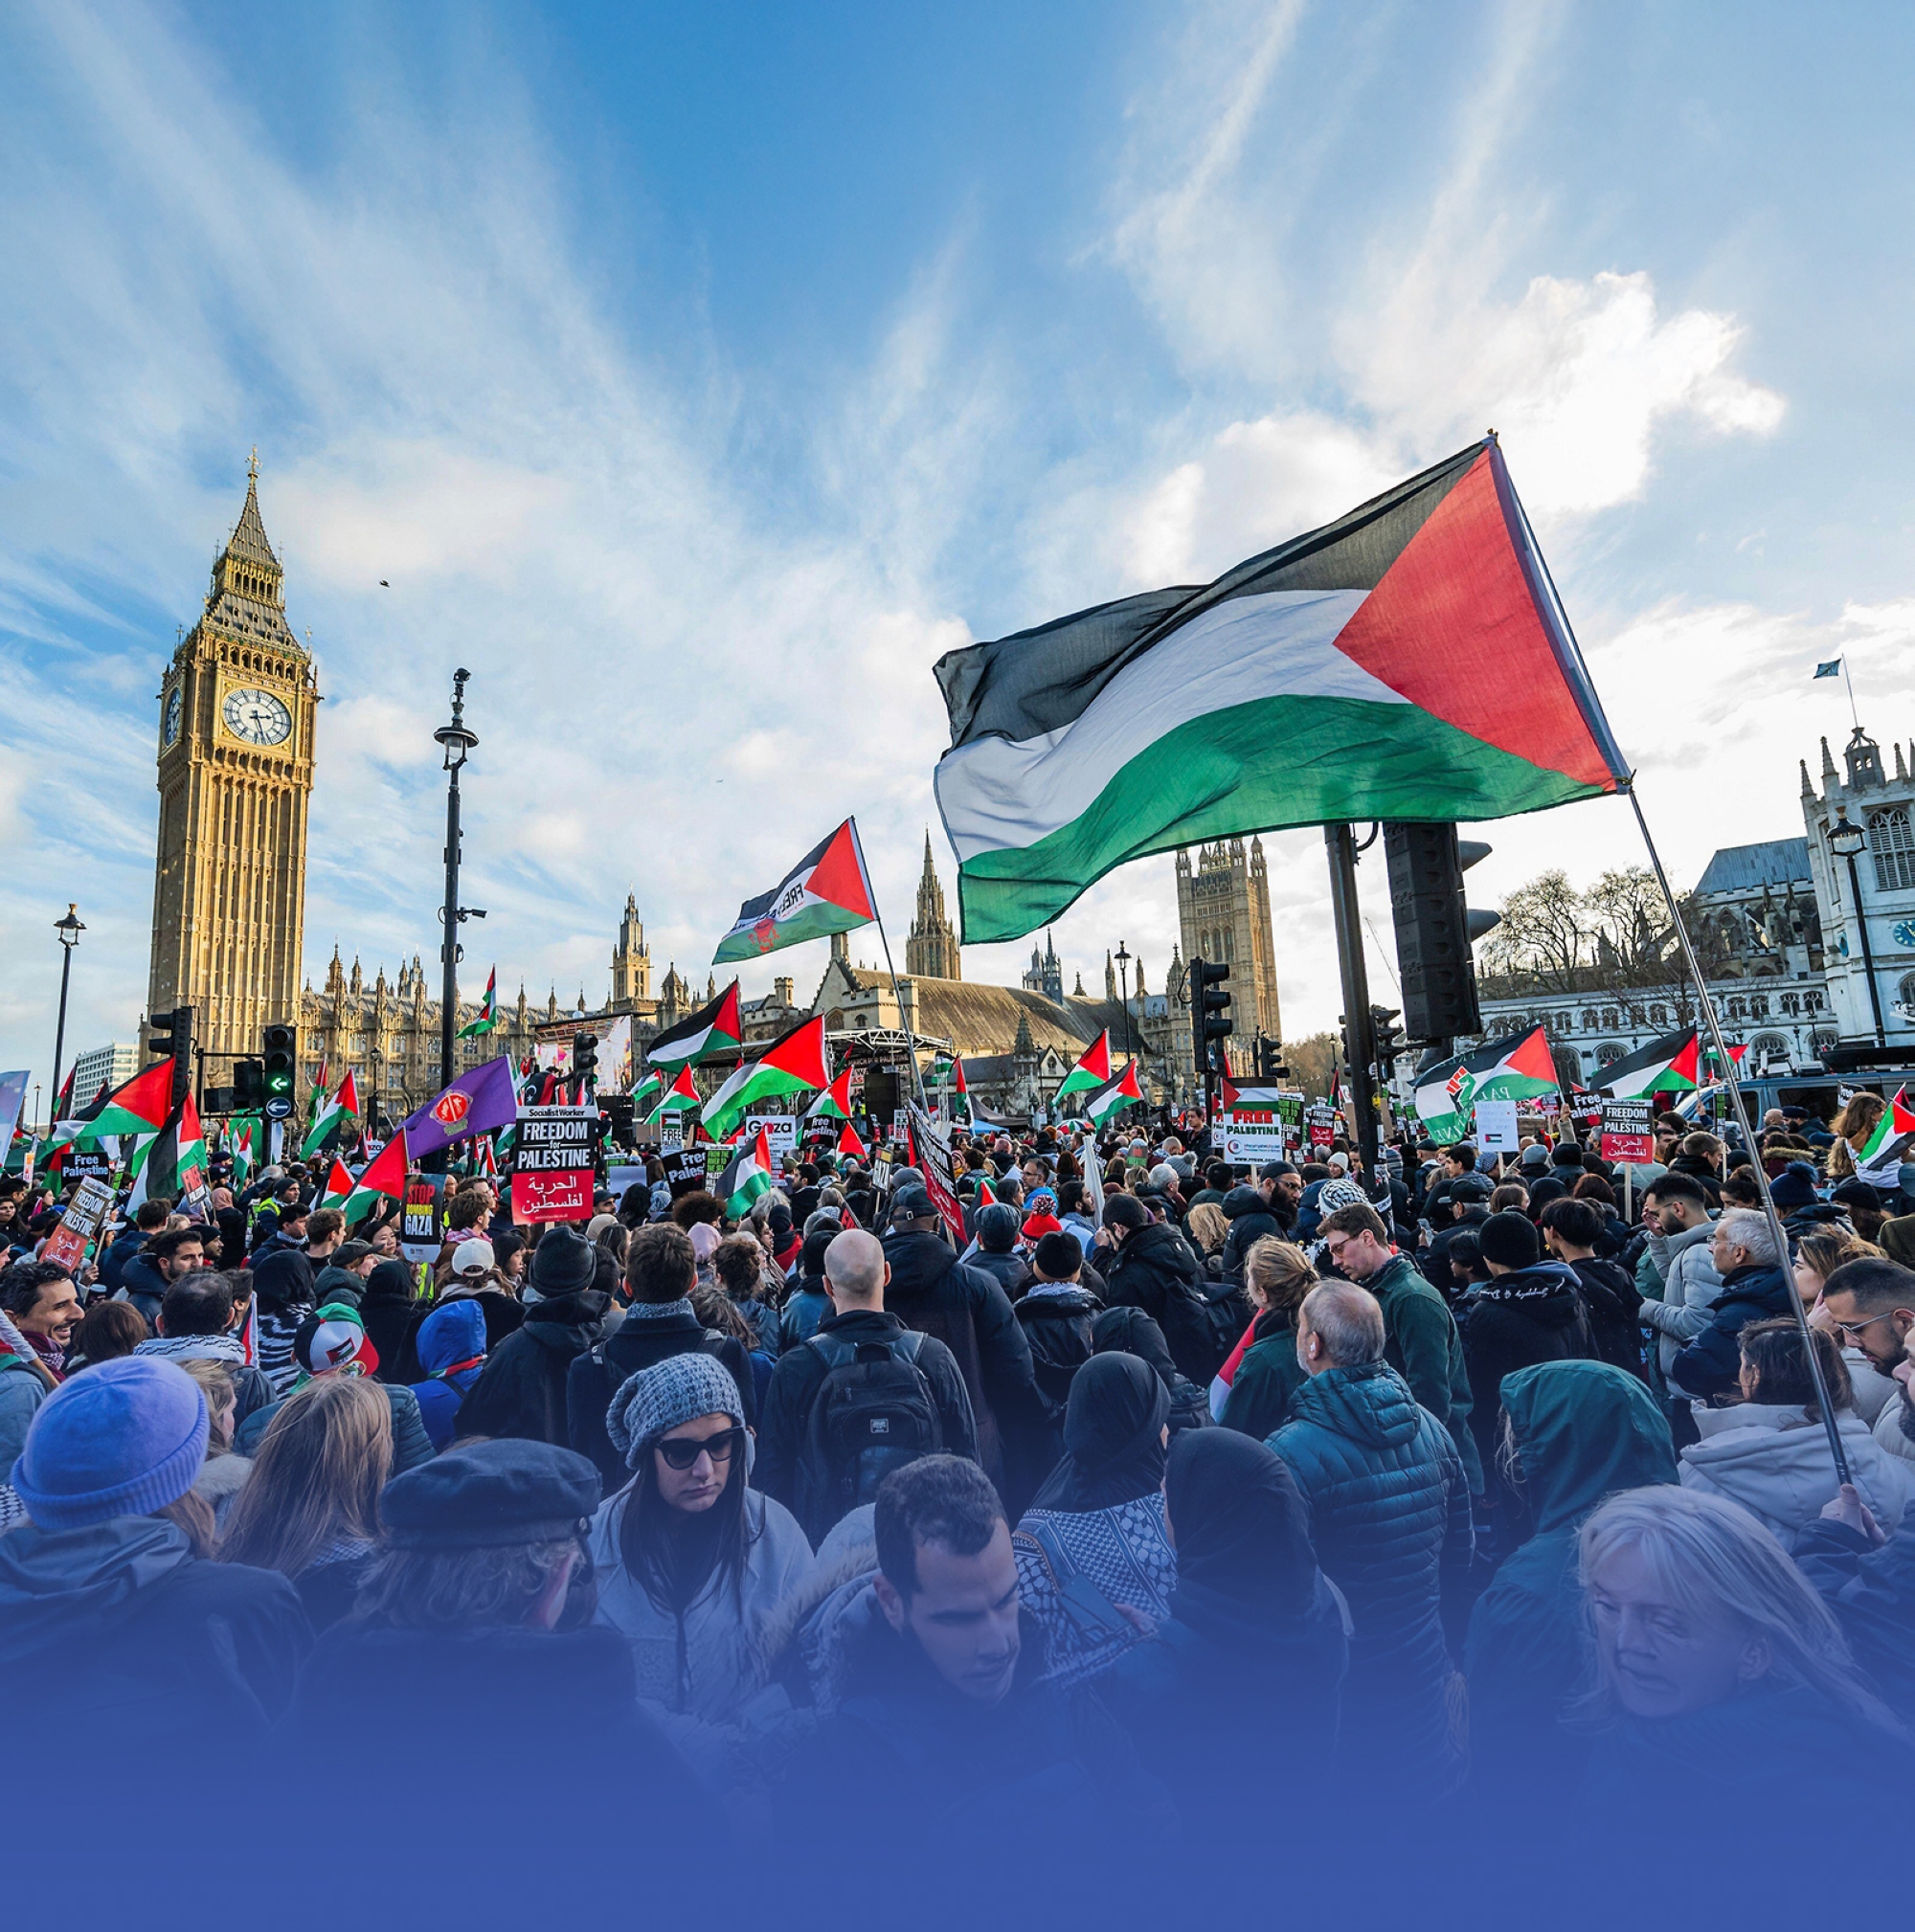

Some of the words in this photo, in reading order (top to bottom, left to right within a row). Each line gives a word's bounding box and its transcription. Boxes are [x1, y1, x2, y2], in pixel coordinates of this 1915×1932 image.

[1573, 1093, 1601, 1107] Free
[529, 1109, 557, 1117] Socialist
[1232, 1109, 1273, 1124] FREE
[1607, 1107, 1647, 1119] FREEDOM
[523, 1121, 588, 1140] FREEDOM
[1227, 1125, 1279, 1134] PALESTINE
[1605, 1121, 1650, 1134] PALESTINE
[549, 1139, 561, 1149] for
[75, 1155, 99, 1165] Free
[517, 1149, 591, 1169] PALESTINE
[62, 1166, 109, 1177] Palestine
[528, 1175, 577, 1195] الحرية
[407, 1184, 436, 1203] STOP
[406, 1203, 434, 1215] BOMBING
[521, 1193, 583, 1214] لفلسطين
[405, 1215, 433, 1236] GAZA
